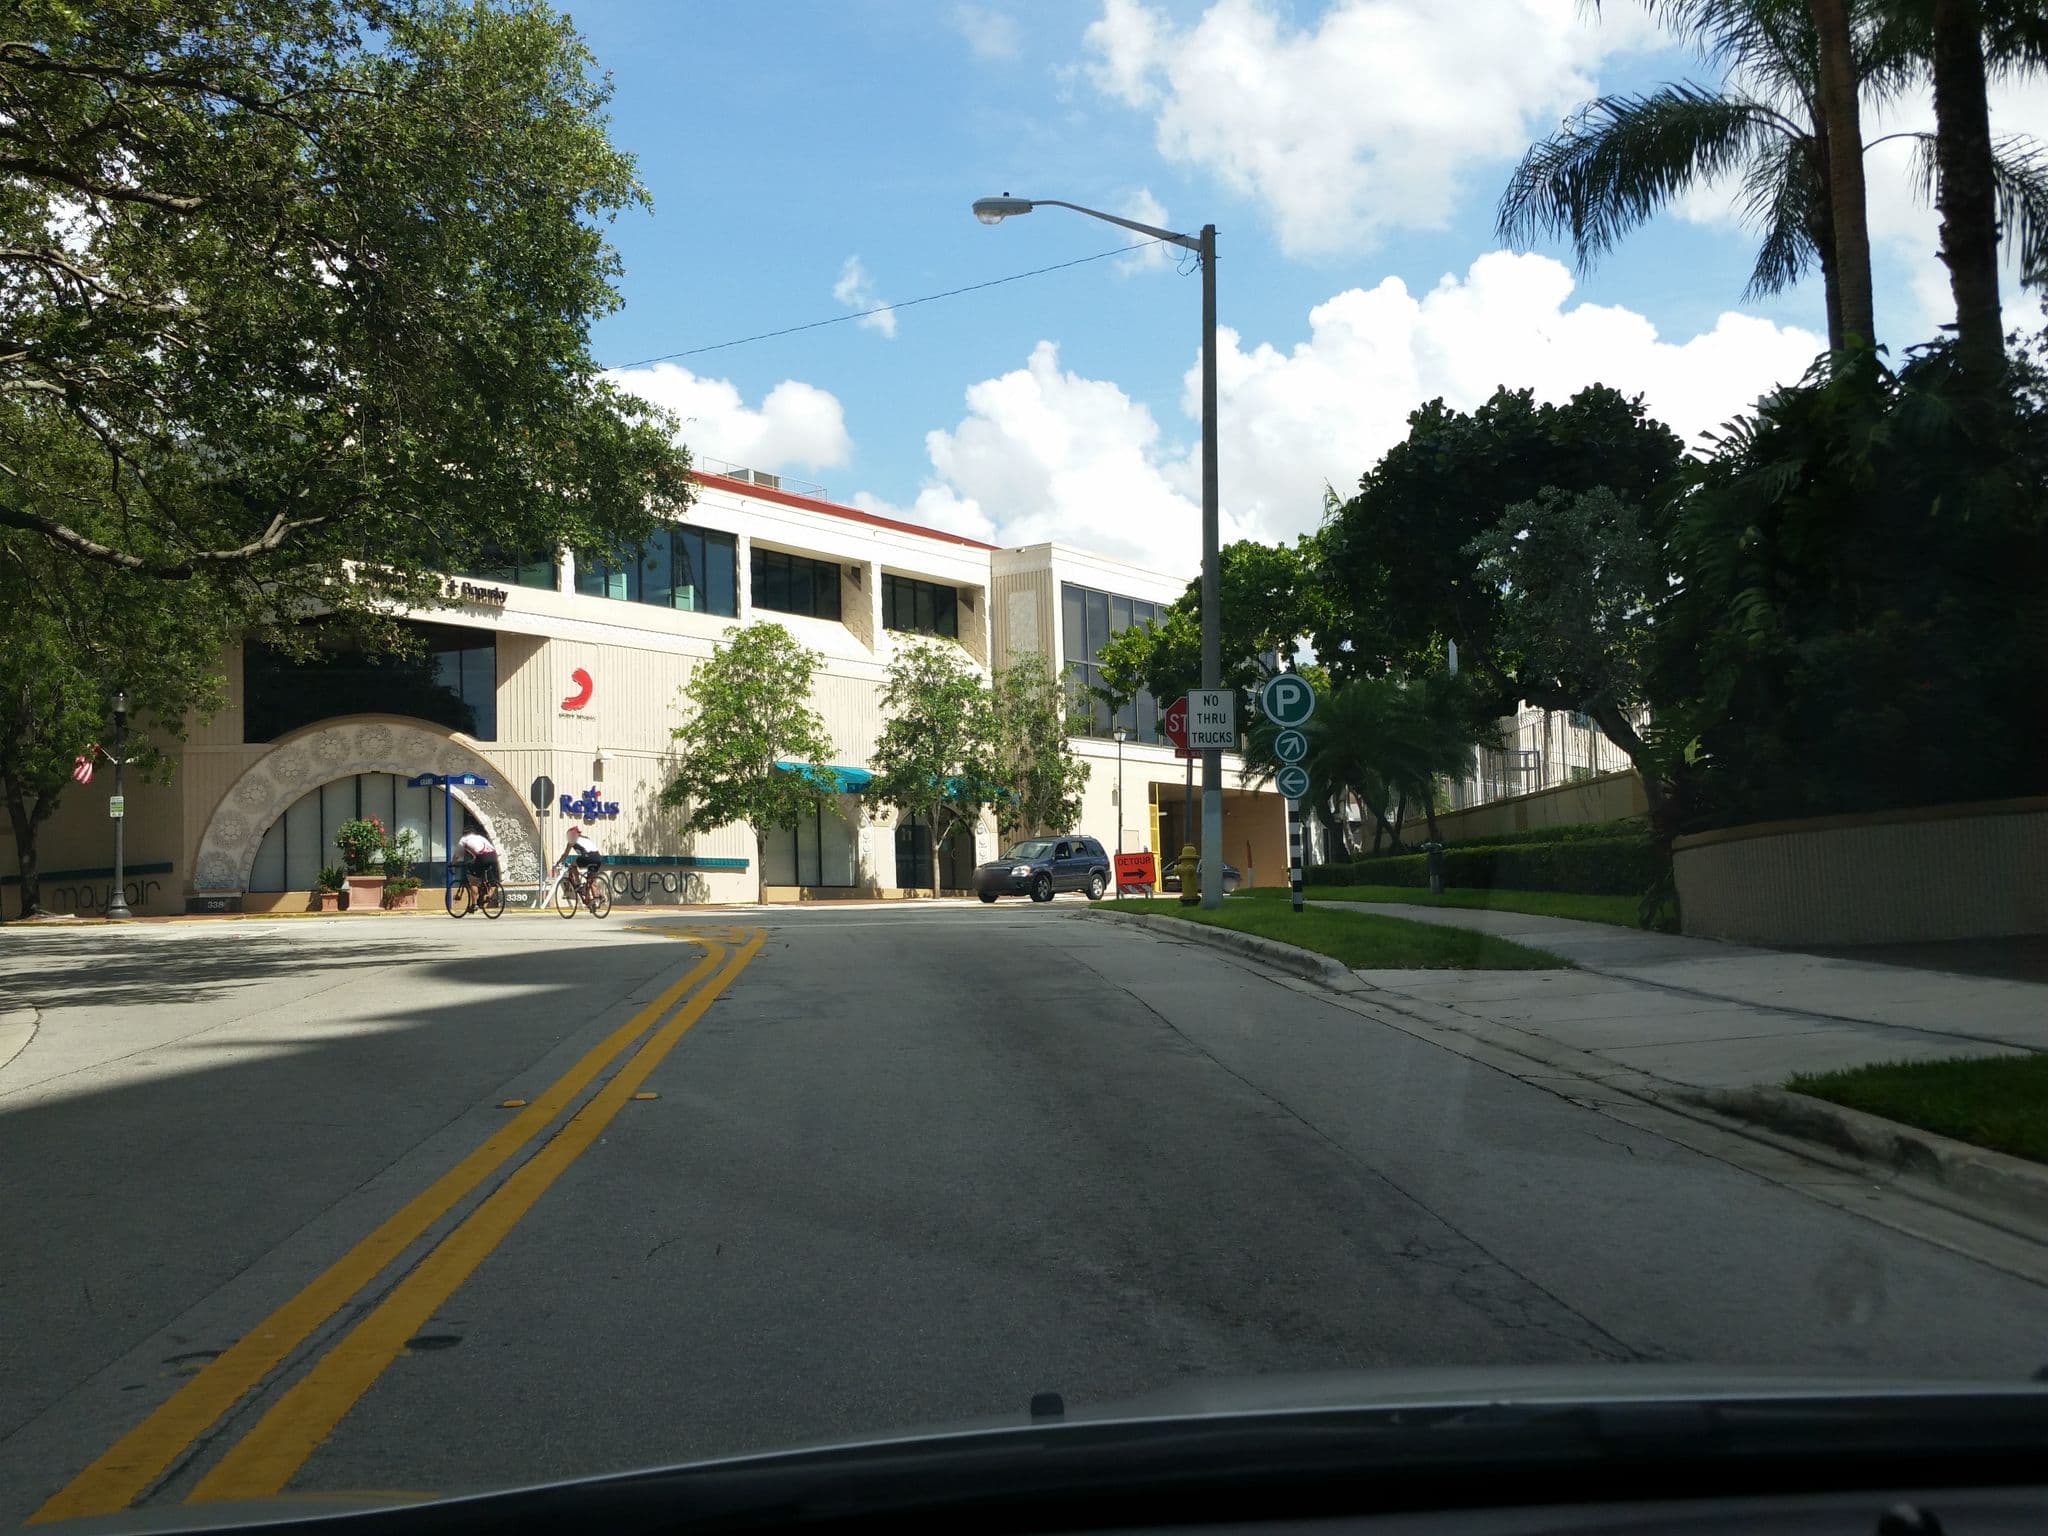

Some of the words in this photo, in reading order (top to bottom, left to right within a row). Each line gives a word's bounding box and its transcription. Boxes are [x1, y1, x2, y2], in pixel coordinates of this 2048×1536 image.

[1203, 695, 1219, 706] NO
[1276, 684, 1300, 716] P
[1168, 714, 1187, 732] ST
[1198, 713, 1226, 724] THRU
[1191, 732, 1233, 743] TRUCKS
[560, 787, 619, 819] Regus
[1117, 856, 1151, 866] DETOUR
